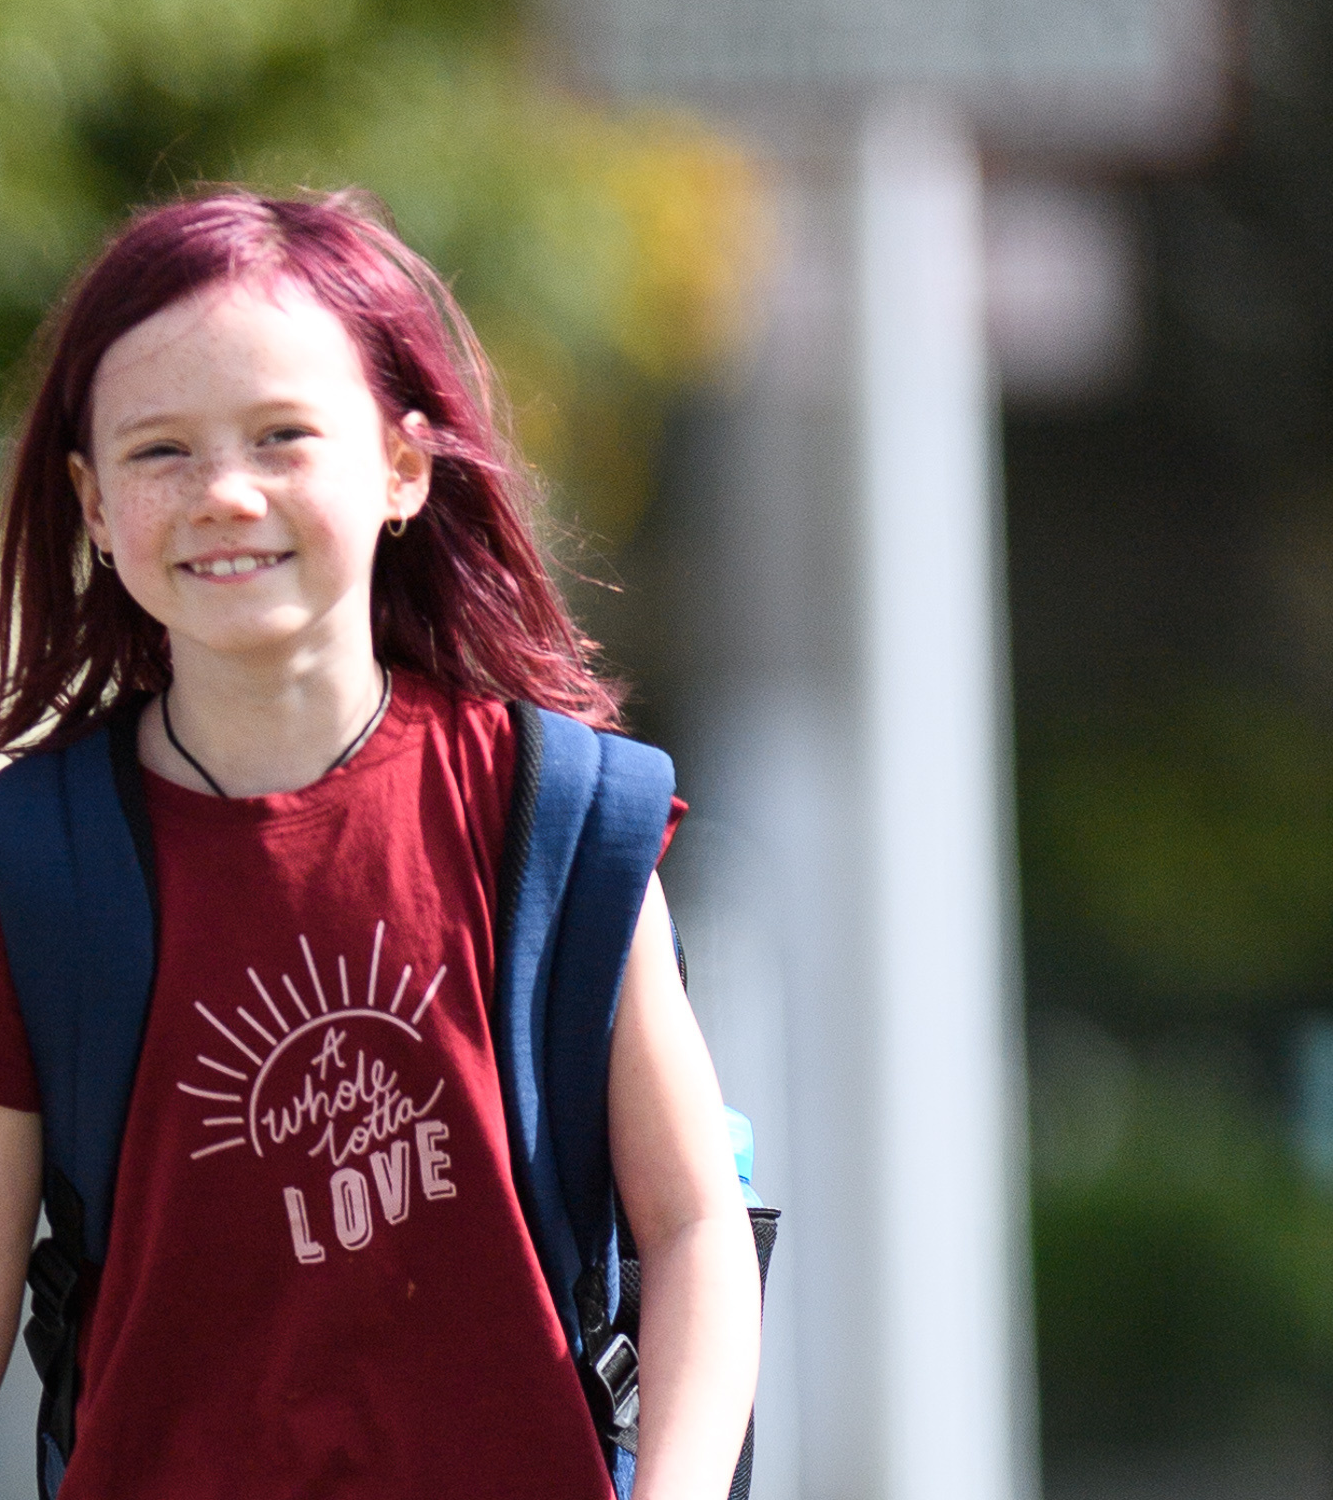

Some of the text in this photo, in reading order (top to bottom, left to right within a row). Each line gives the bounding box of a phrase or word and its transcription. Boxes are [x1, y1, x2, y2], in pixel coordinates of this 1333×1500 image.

[260, 1049, 398, 1144] whole
[310, 1026, 347, 1081] A
[308, 1078, 445, 1167] lotta
[283, 1119, 457, 1264] LOVE
